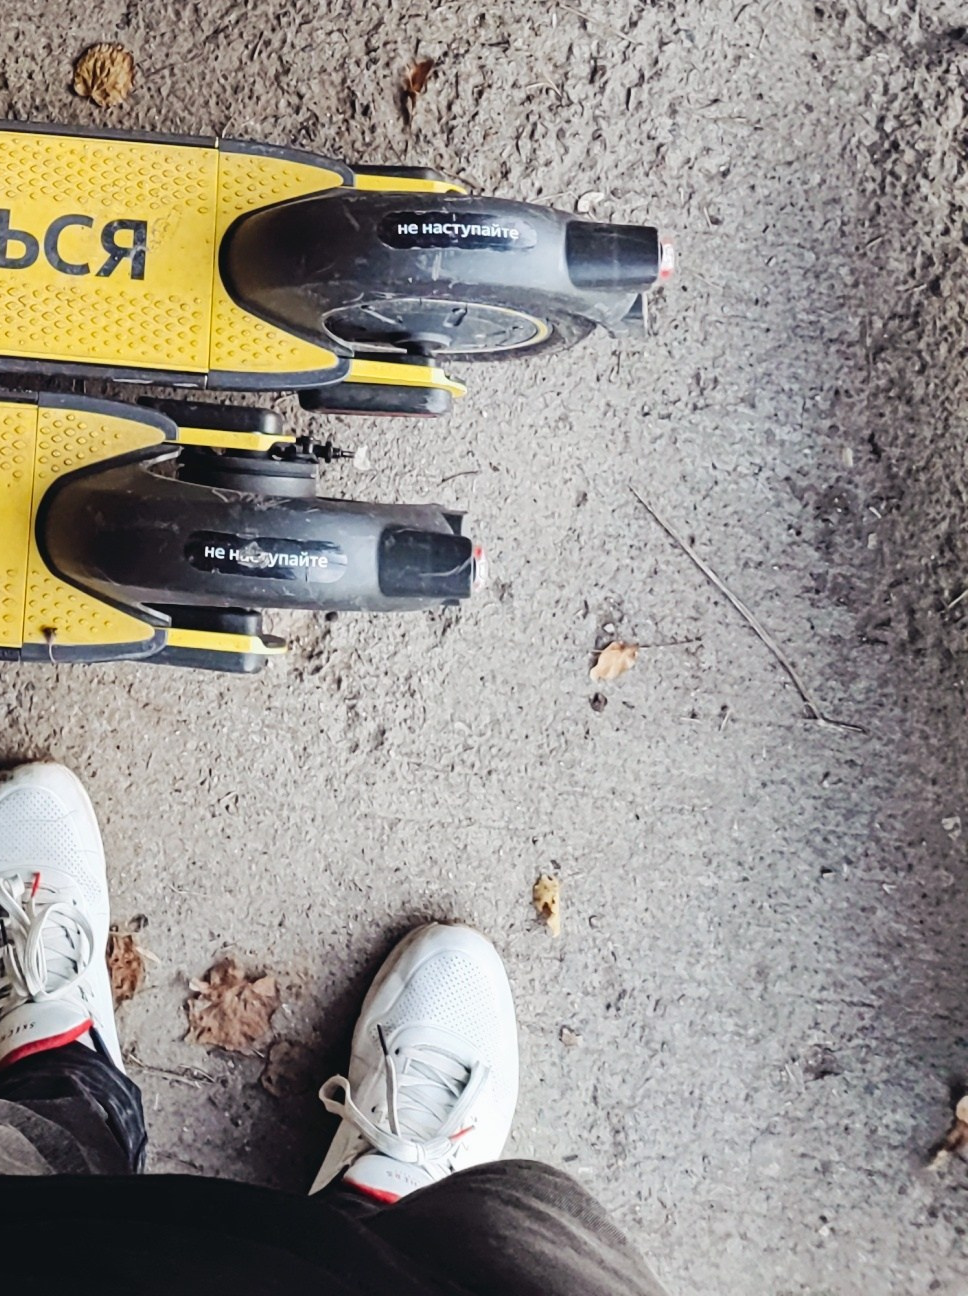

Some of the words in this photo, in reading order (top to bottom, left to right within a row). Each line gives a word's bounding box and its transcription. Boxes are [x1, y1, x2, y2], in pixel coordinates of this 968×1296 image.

[397, 223, 419, 235] не
[422, 221, 520, 240] наступайте
[204, 546, 225, 559] не
